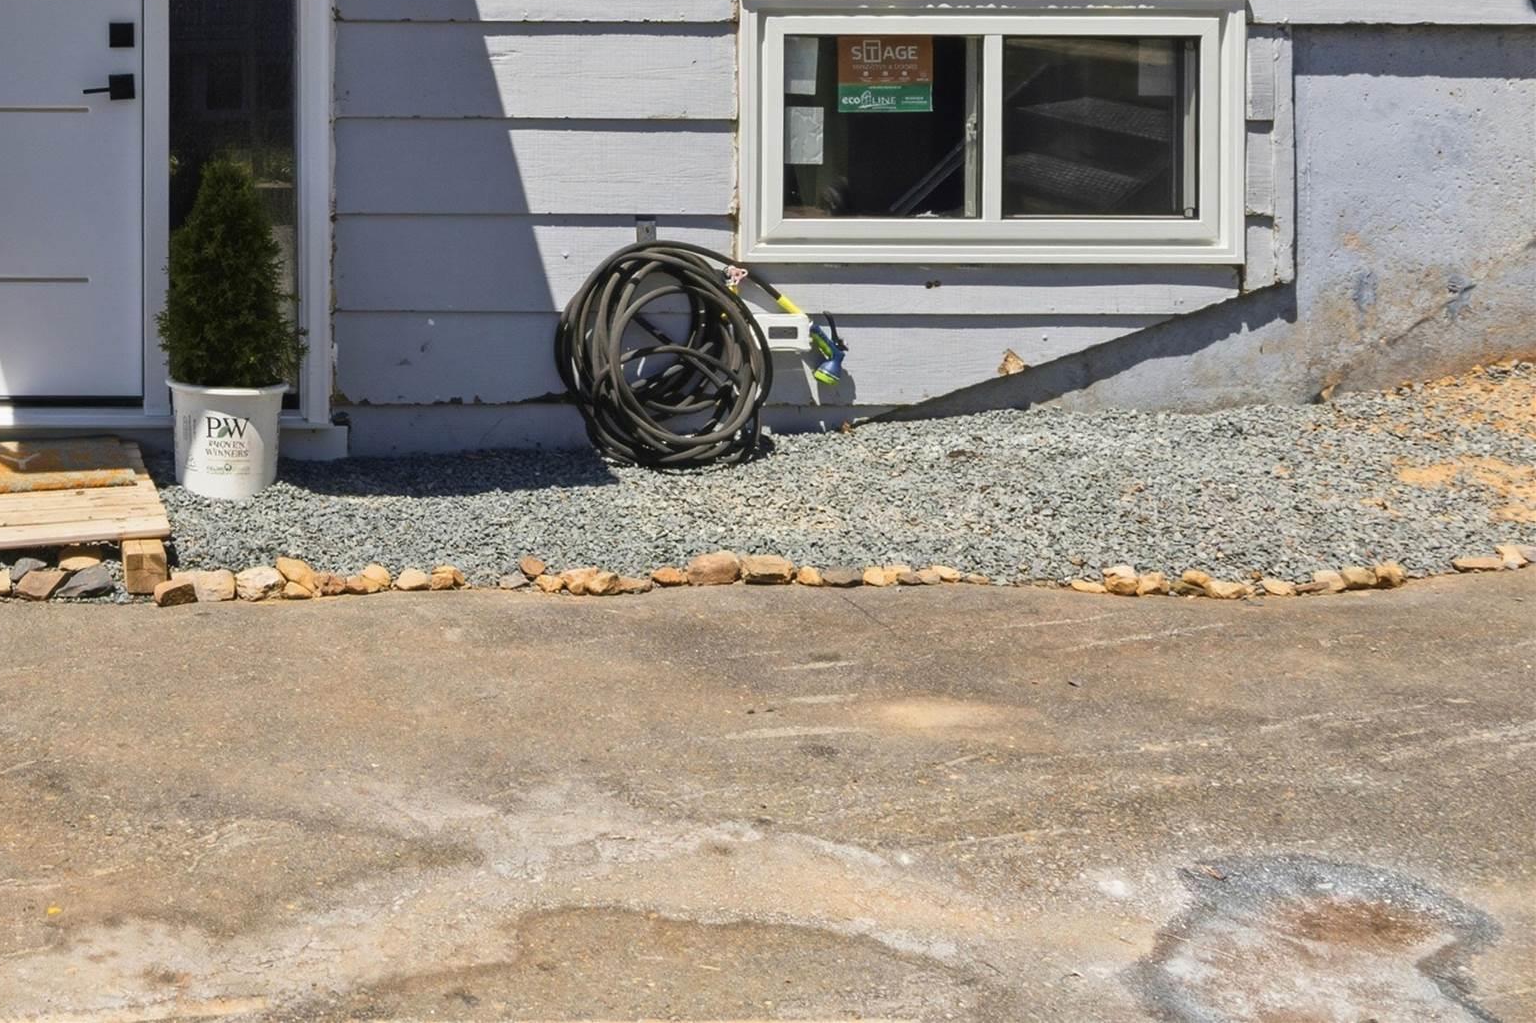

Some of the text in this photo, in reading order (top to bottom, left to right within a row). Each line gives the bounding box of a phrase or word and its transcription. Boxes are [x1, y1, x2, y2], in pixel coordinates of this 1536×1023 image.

[851, 42, 918, 62] STAGE
[209, 440, 246, 449] PROVEN
[205, 448, 249, 457] WINNERS
